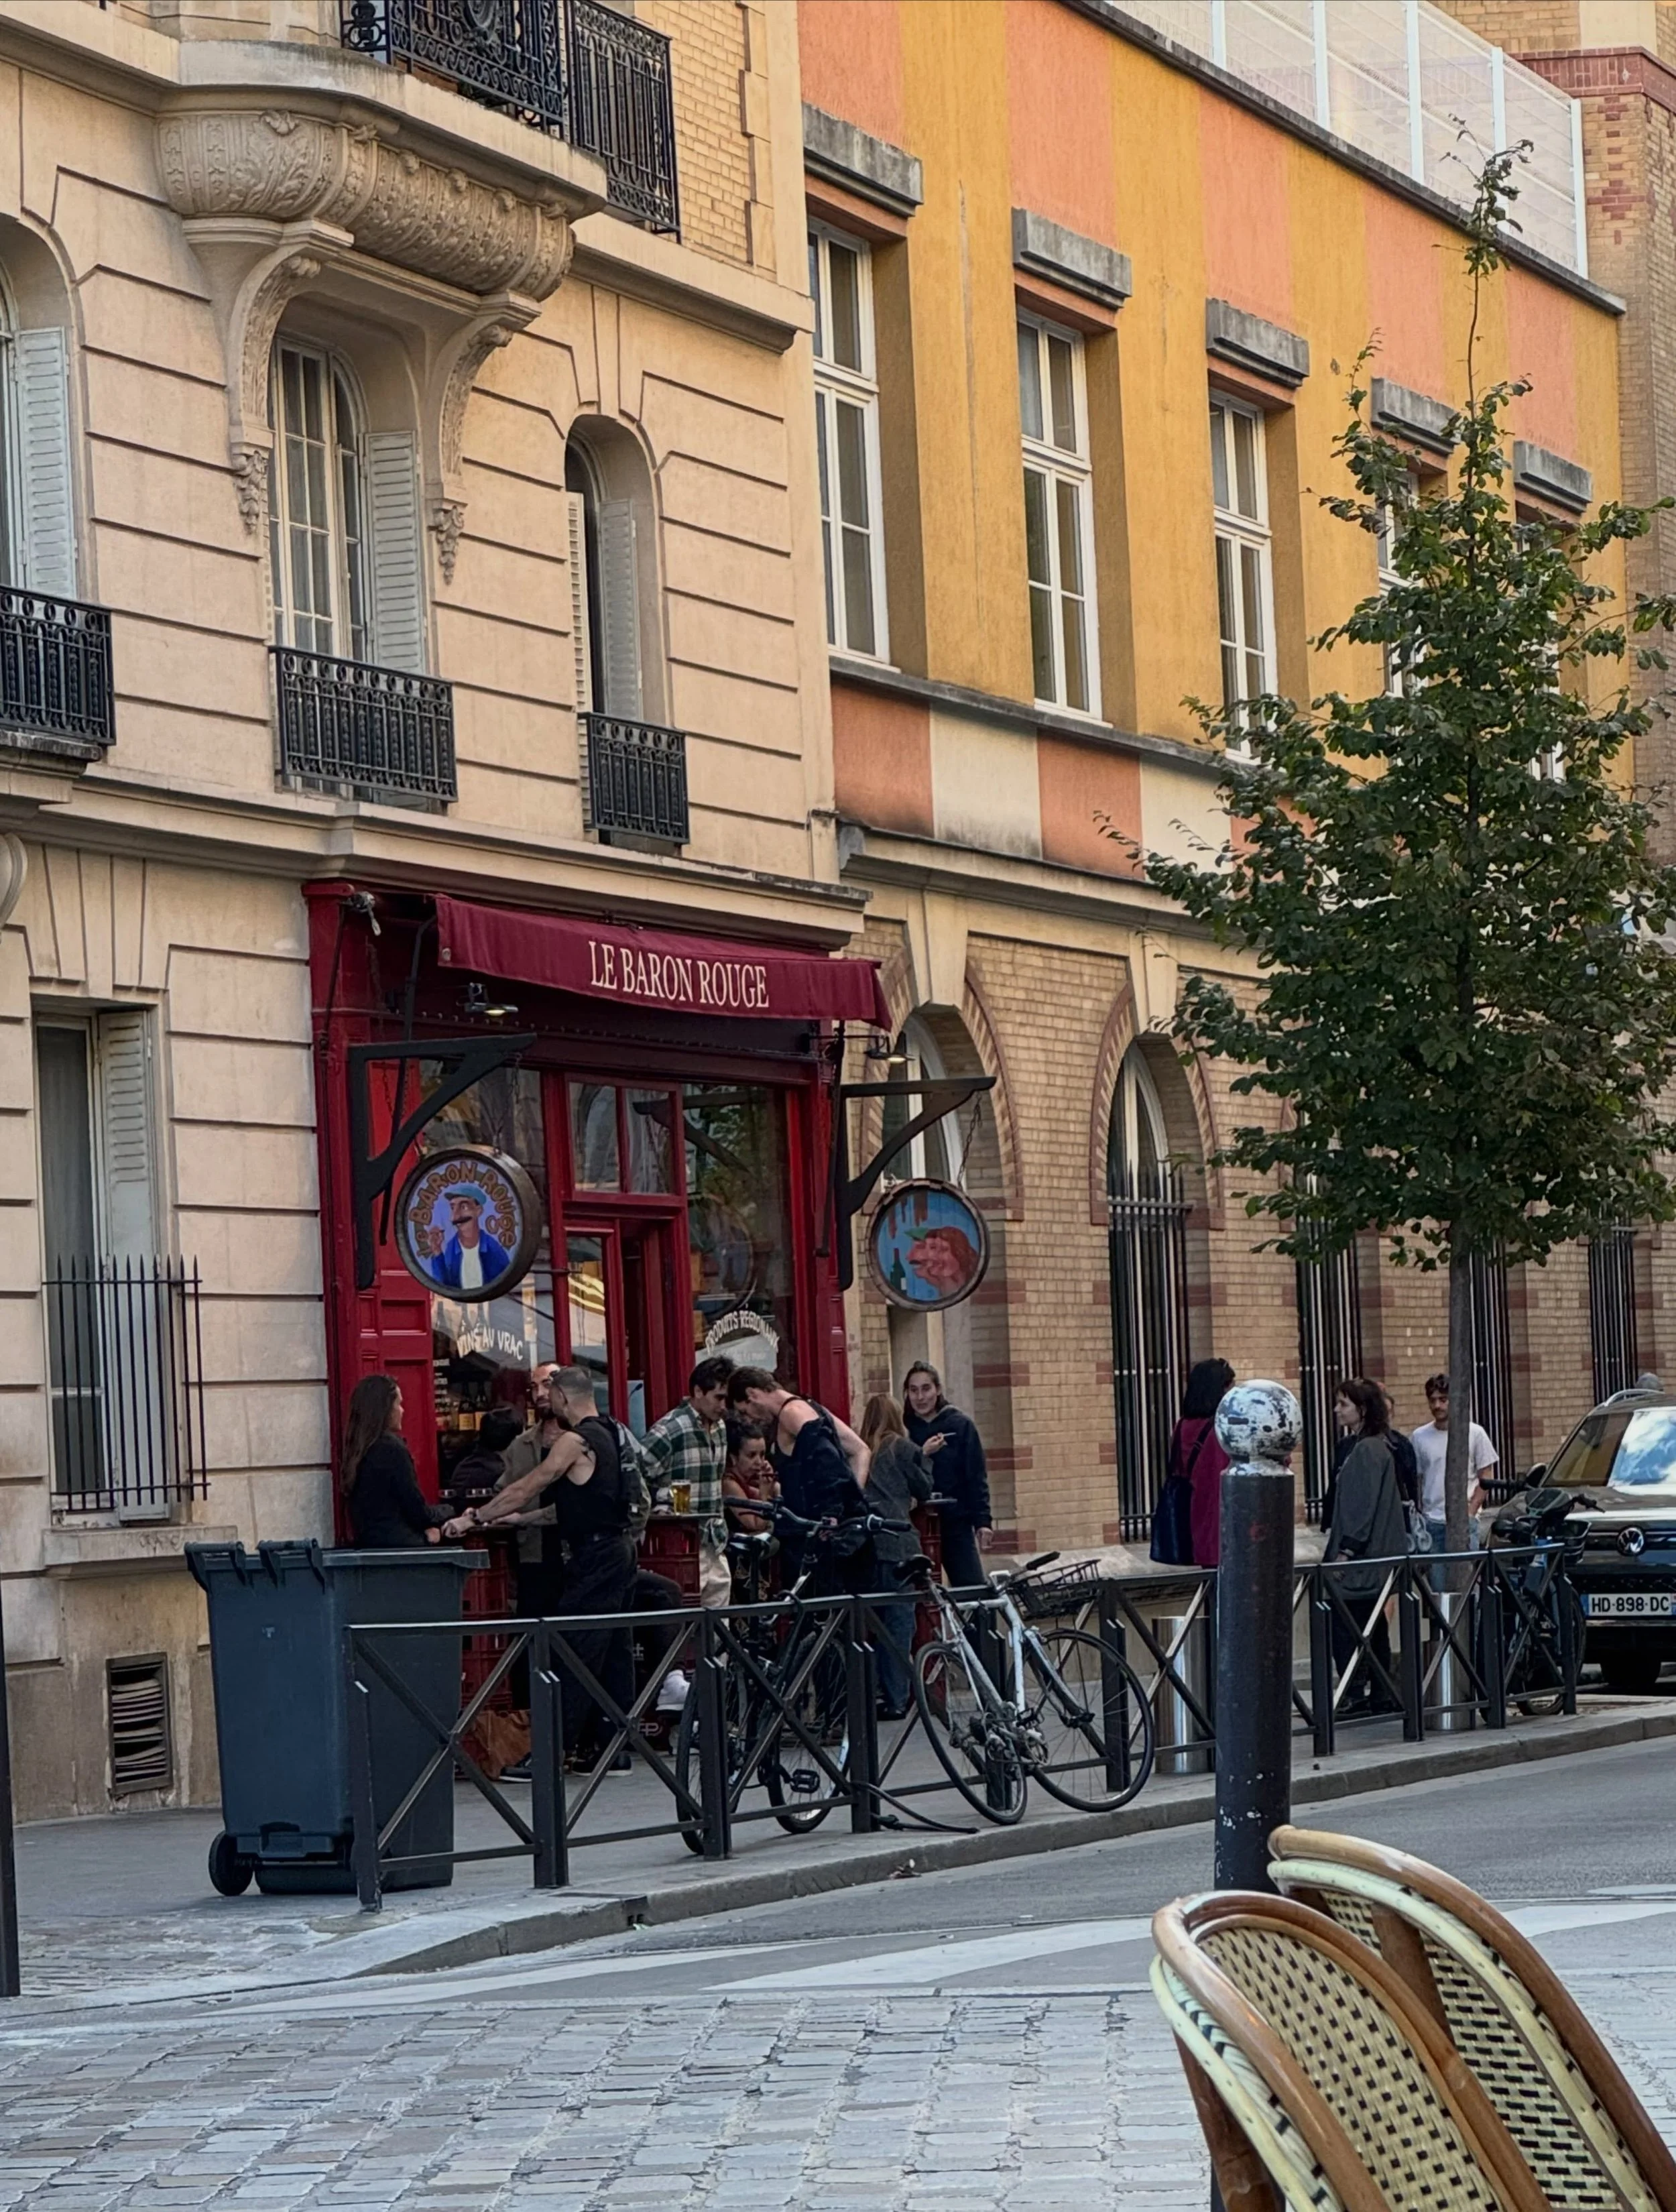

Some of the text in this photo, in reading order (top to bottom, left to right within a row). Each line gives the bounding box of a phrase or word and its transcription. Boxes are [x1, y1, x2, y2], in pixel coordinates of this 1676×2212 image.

[589, 941, 769, 1008] LE BARON ROUGE
[482, 1326, 495, 1348] AU
[497, 1330, 524, 1361] VRAC
[705, 1310, 738, 1355] PRODUITS
